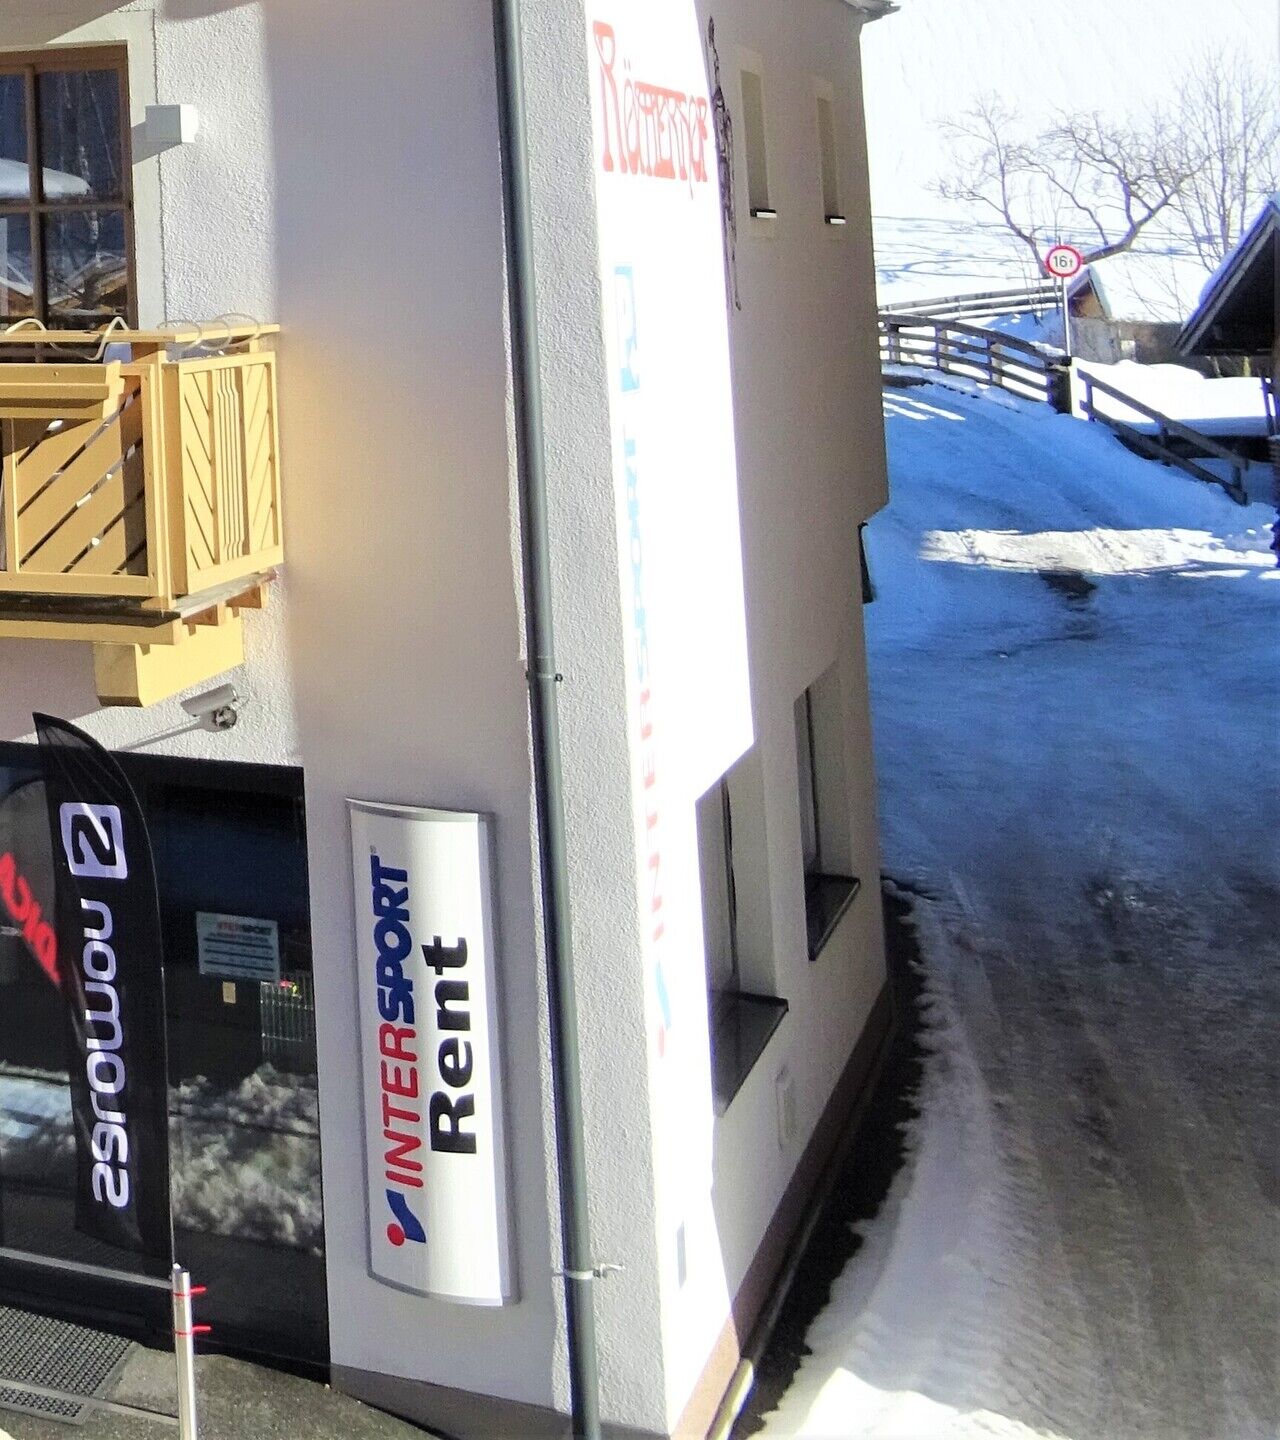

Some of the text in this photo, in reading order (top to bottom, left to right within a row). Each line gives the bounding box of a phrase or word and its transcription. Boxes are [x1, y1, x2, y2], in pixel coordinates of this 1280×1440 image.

[1055, 255, 1068, 268] 16
[623, 430, 665, 943] INTERSPORT
[370, 854, 424, 1188] INTERSPORT
[421, 935, 478, 1155] Rent
